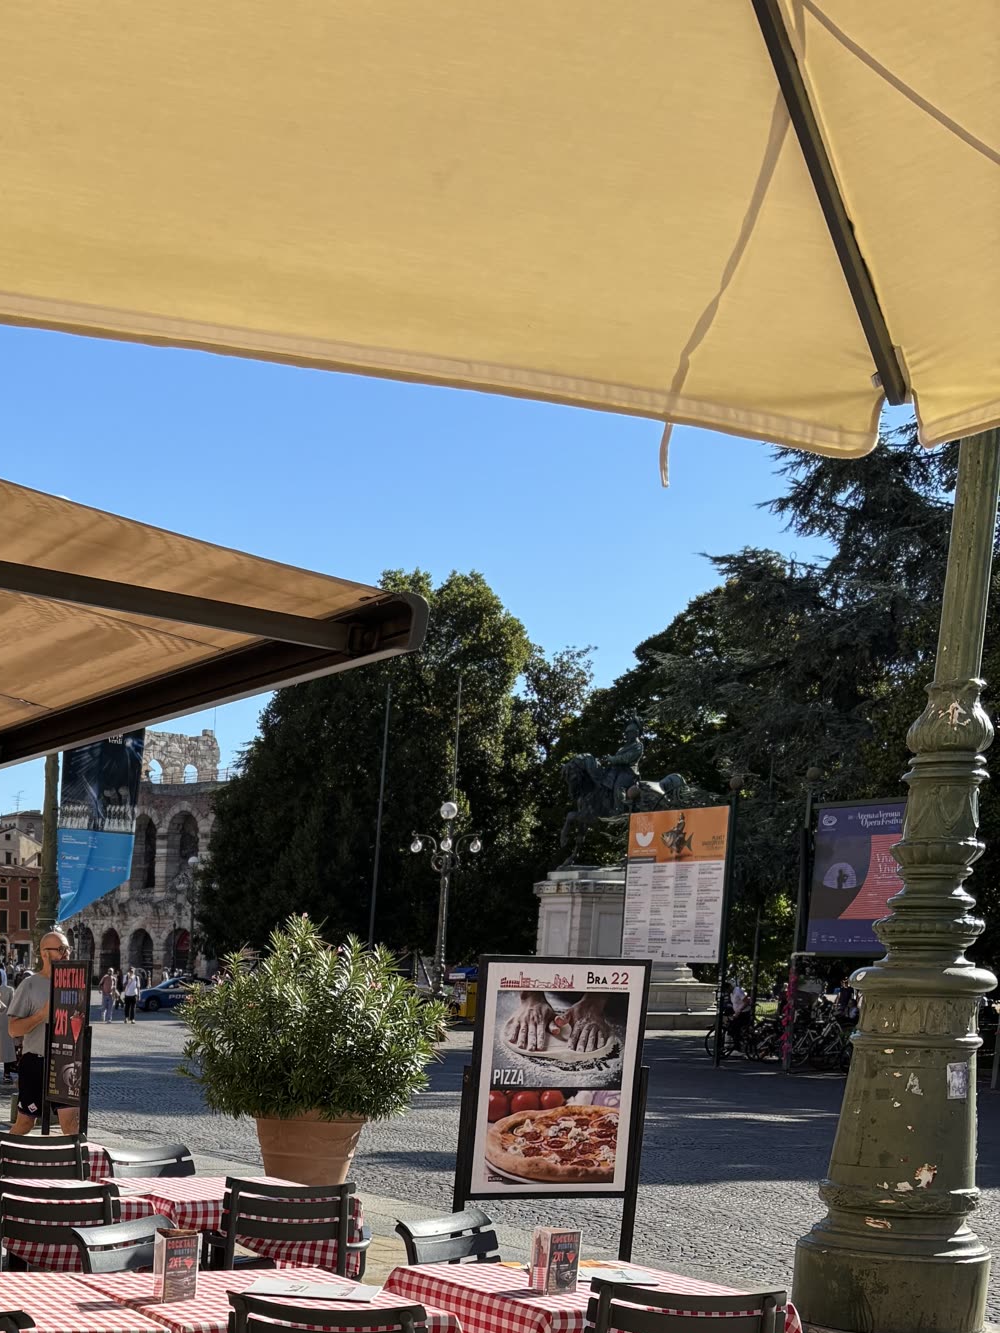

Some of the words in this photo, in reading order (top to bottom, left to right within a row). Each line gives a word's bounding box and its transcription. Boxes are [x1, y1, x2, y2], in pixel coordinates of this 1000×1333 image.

[881, 817, 903, 825] Festiva
[54, 968, 86, 989] COCKTAIL
[610, 971, 629, 985] 22
[54, 1008, 68, 1036] 2X1
[493, 1069, 524, 1085] PIZZA
[167, 1238, 197, 1250] COCKTAIL
